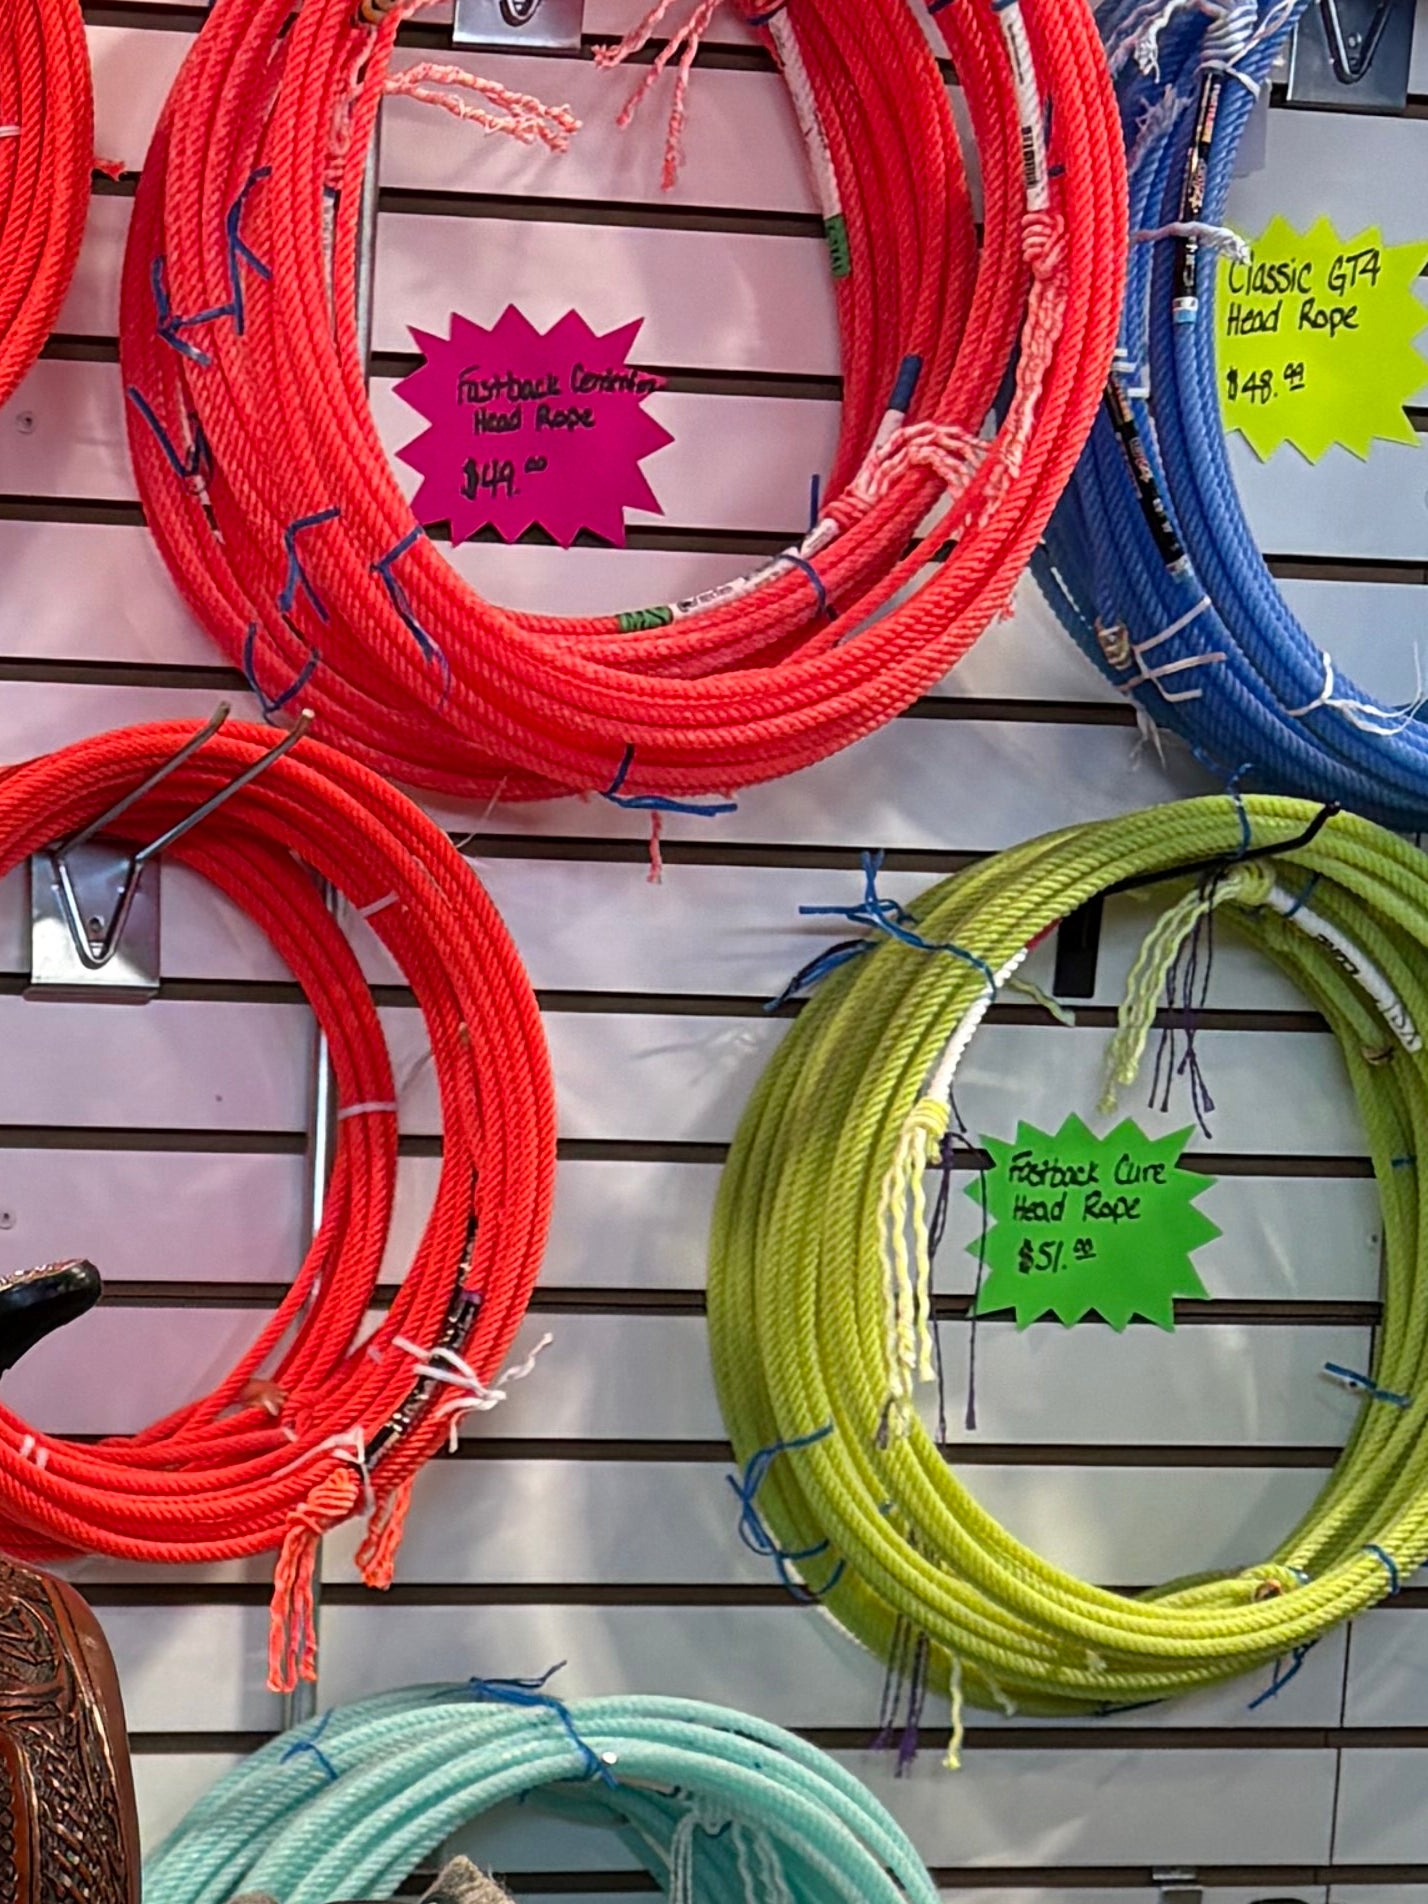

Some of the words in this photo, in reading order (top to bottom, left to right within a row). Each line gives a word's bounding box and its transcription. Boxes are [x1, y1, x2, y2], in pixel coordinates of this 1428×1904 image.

[1228, 253, 1313, 296] Classic
[1328, 248, 1382, 296] GT4
[1227, 299, 1283, 336] Head
[1298, 297, 1360, 338] Rope
[457, 363, 562, 405] Fastback
[474, 405, 523, 436] Head
[535, 404, 596, 432] Rope
[1008, 1150, 1099, 1188] Fastback
[1114, 1153, 1167, 1185] Cure
[1012, 1191, 1068, 1223] Head
[1082, 1190, 1142, 1224] Rope
